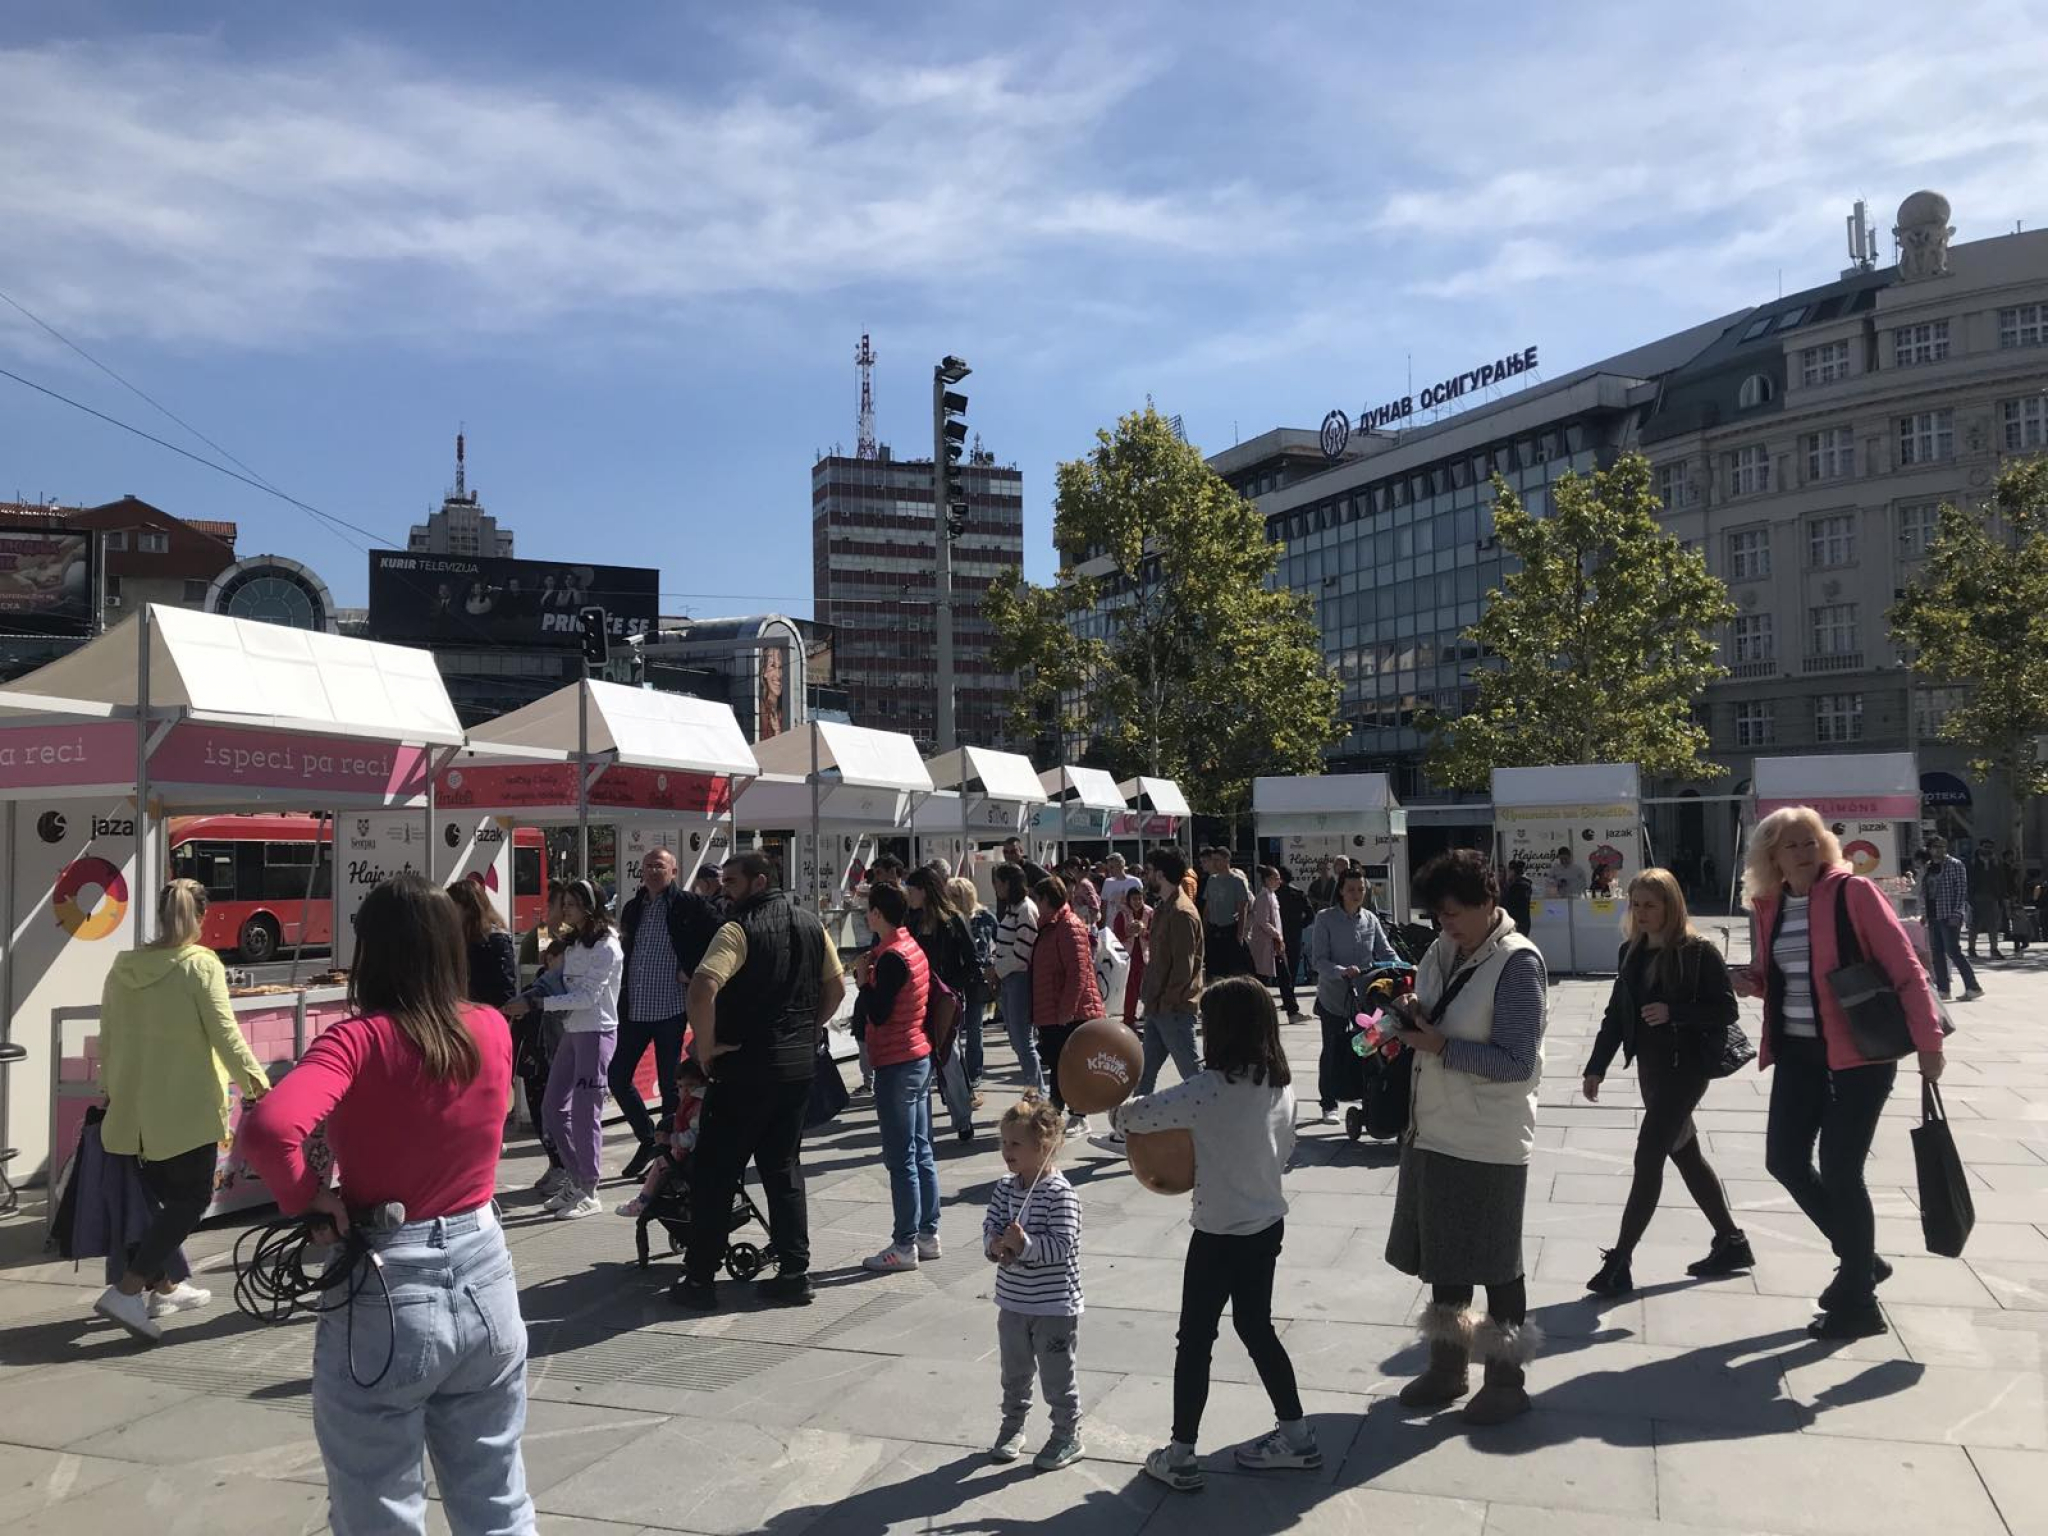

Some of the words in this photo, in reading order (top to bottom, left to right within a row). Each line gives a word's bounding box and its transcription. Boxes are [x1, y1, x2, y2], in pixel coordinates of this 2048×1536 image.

[1359, 396, 1413, 436] ДУНАВ
[1420, 345, 1538, 409] ОСИГУРАЊЕ
[380, 557, 416, 570] KURIR
[418, 560, 480, 574] TELEVIZIJA
[626, 618, 650, 635] SE
[25, 737, 88, 765] reci
[205, 740, 295, 773] ispeci
[302, 754, 334, 777] pa
[341, 756, 390, 777] reci
[91, 815, 134, 840] jaza
[473, 827, 503, 846] jazak
[1606, 829, 1633, 840] jazak
[1859, 822, 1888, 834] jazak
